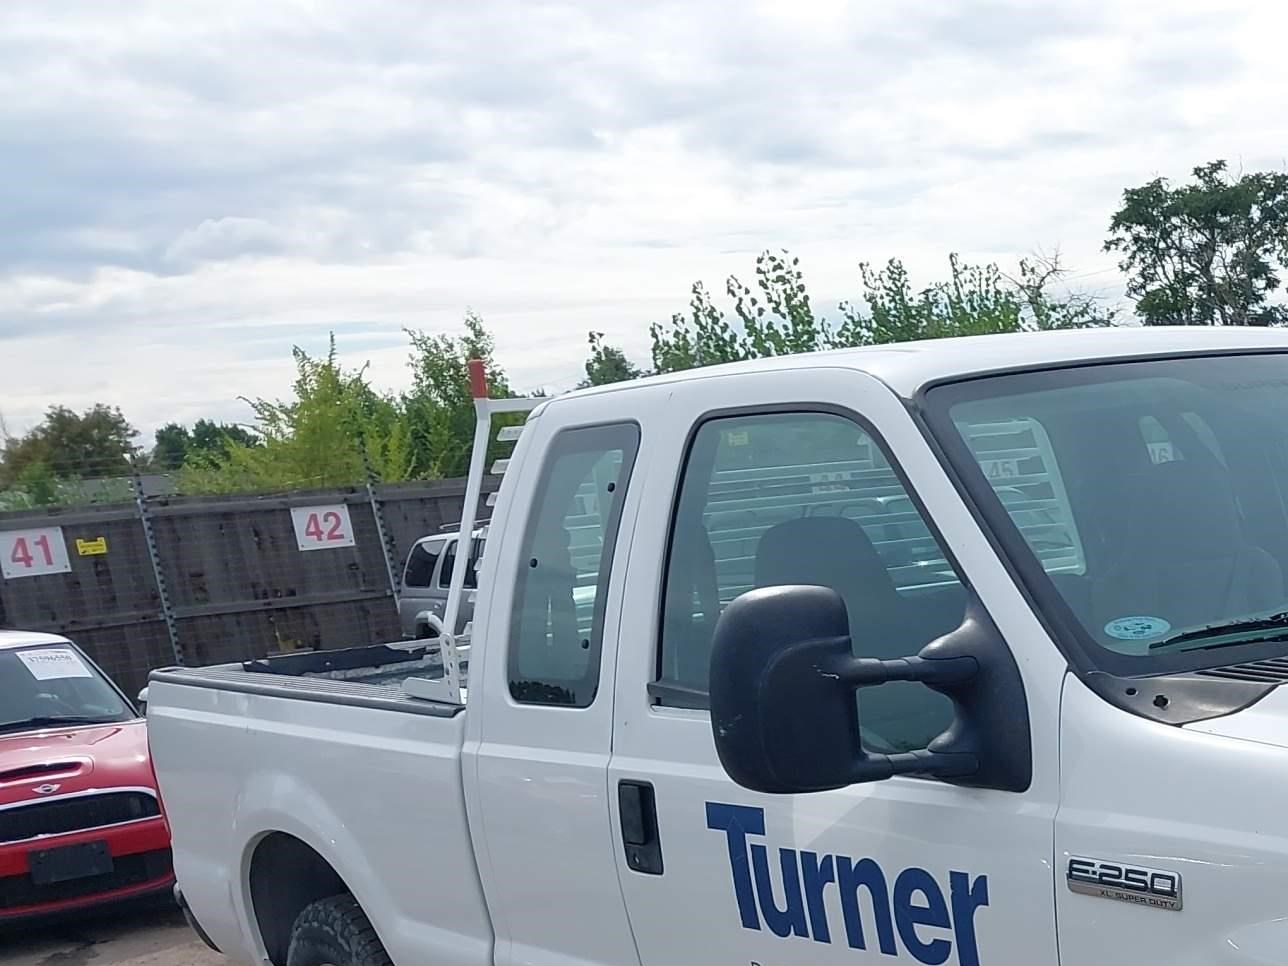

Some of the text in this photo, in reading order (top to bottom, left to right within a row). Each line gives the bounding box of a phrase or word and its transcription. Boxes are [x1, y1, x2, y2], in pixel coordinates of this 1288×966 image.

[305, 511, 345, 541] 42
[11, 534, 53, 568] 41
[1069, 858, 1177, 898] F-250
[1115, 892, 1147, 904] SUPER
[1149, 898, 1176, 909] DUTY
